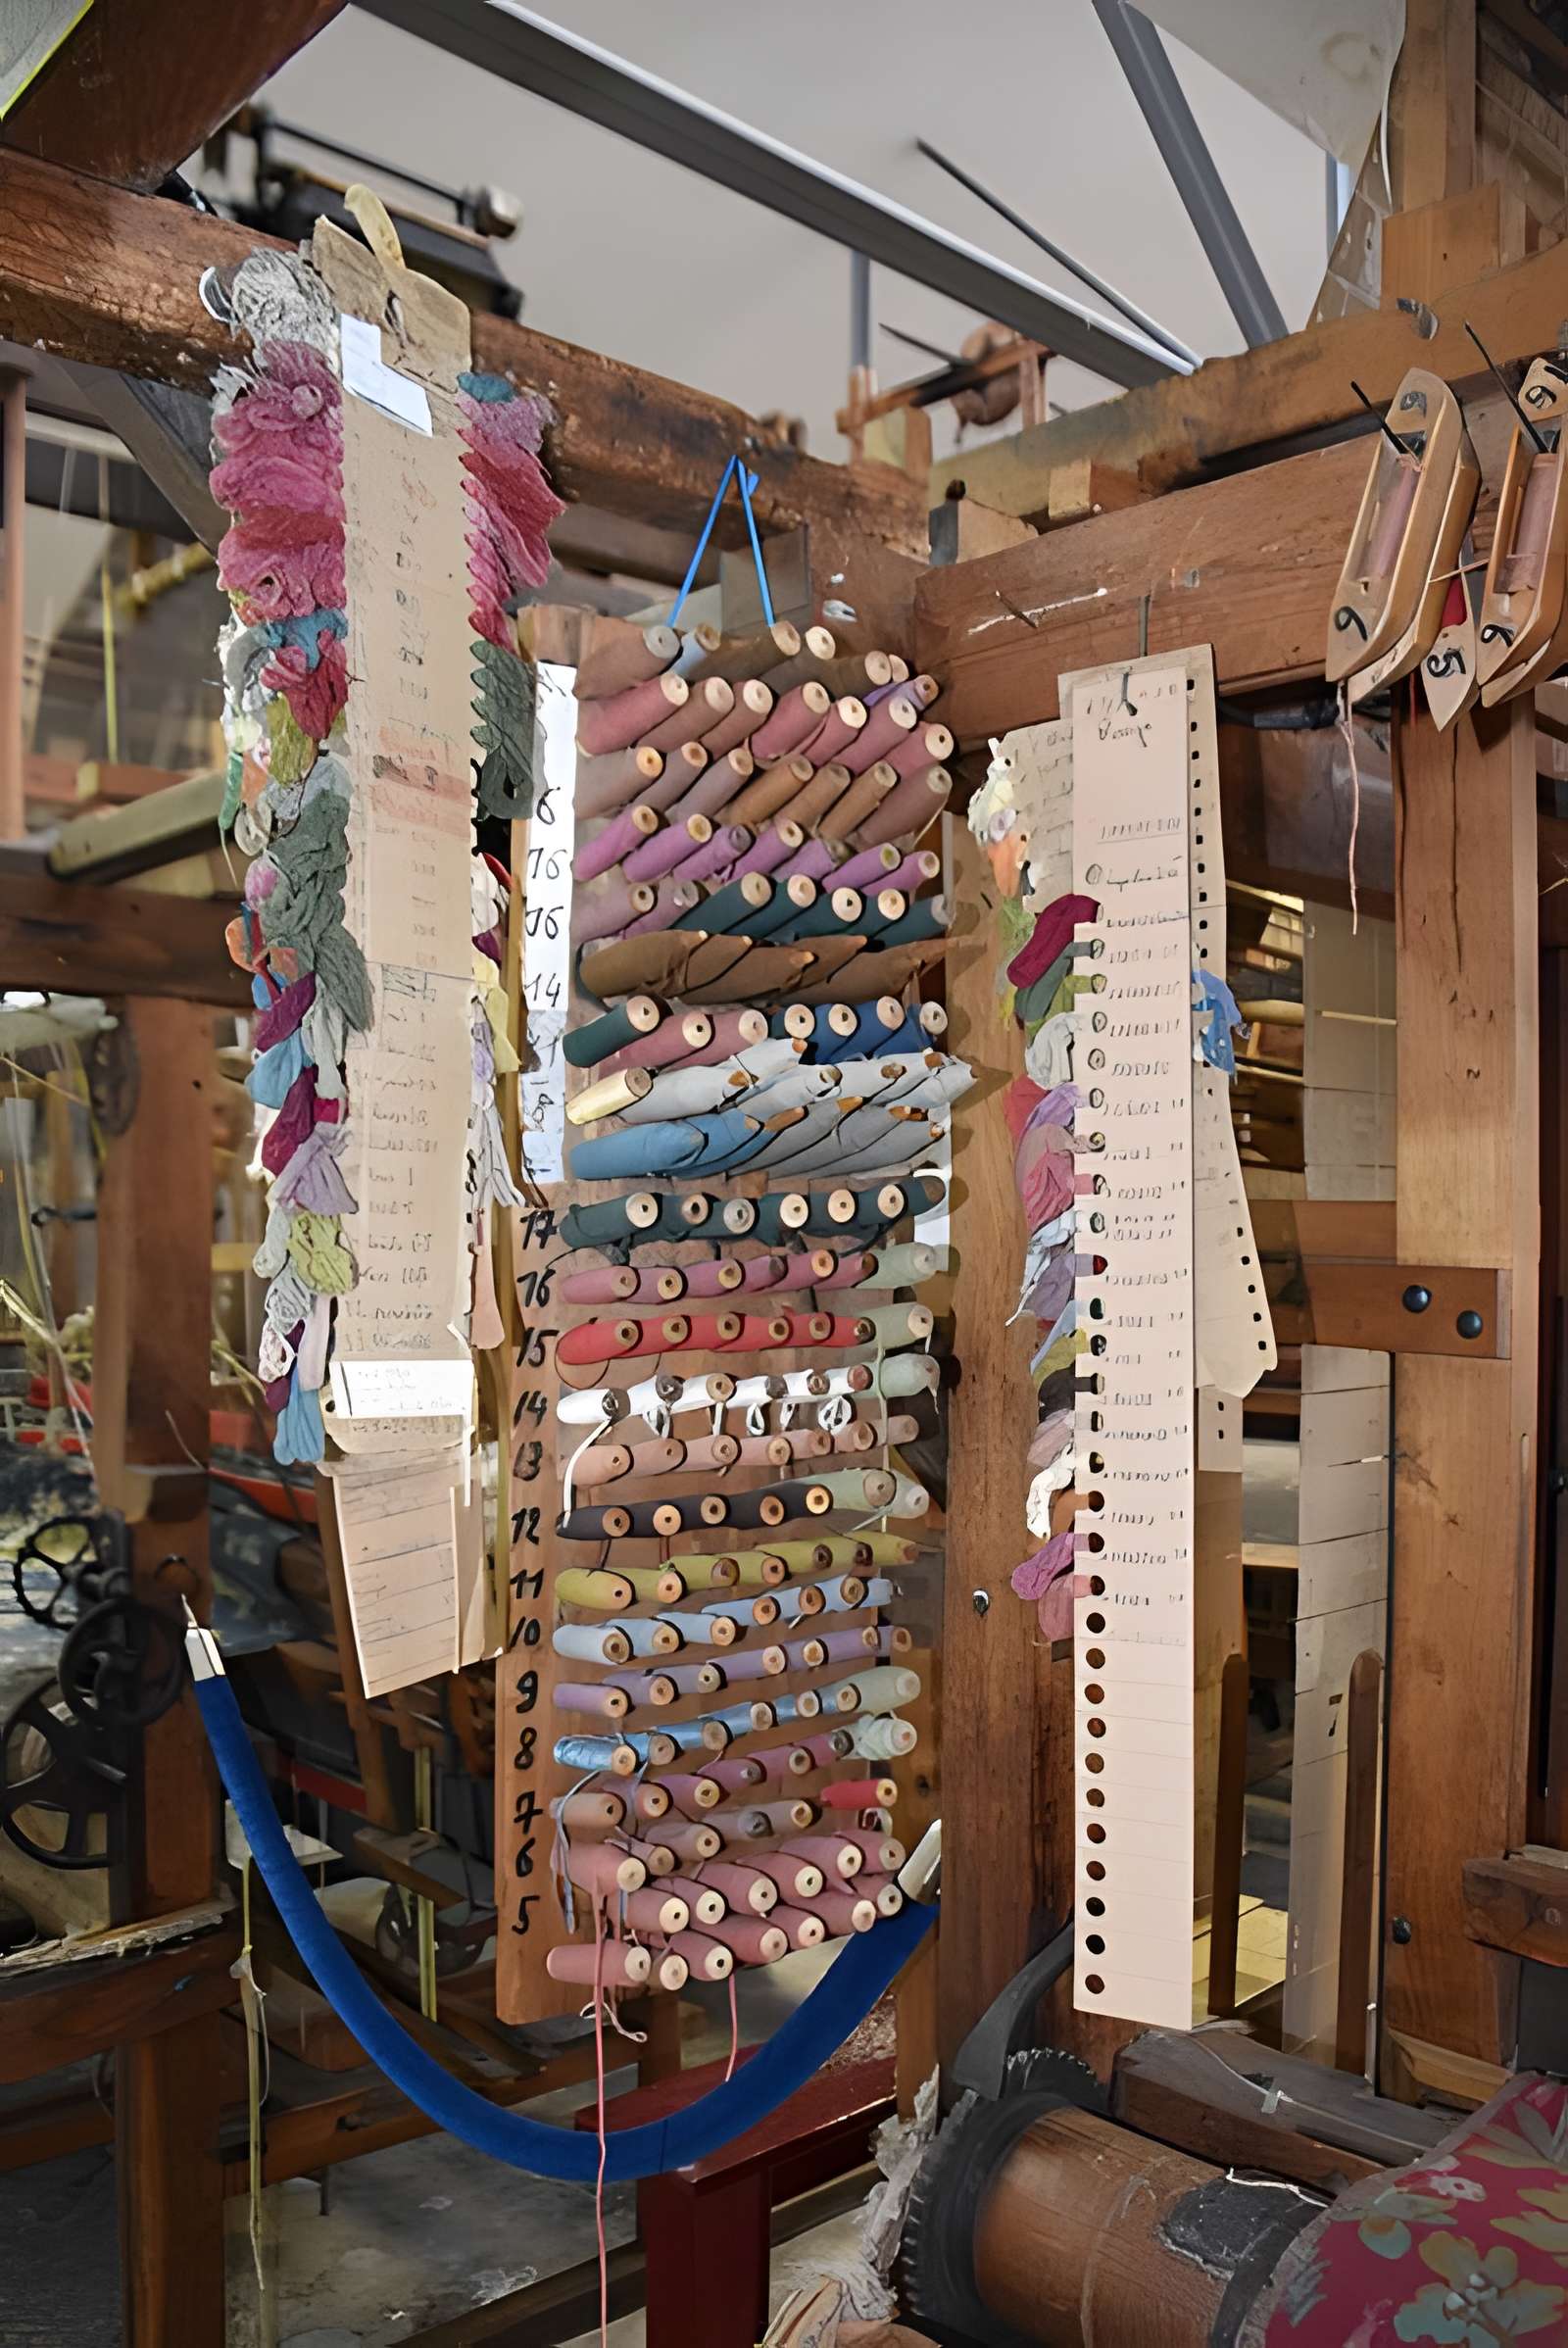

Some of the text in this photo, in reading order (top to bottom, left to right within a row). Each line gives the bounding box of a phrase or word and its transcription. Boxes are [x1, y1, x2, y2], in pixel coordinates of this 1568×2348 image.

[511, 1507, 540, 1544] 12
[509, 1569, 544, 1599] 11
[510, 1616, 540, 1647] 10
[515, 1670, 538, 1713] 9
[514, 1728, 537, 1769] 8
[514, 1791, 543, 1834] 7
[515, 1837, 535, 1878] 6
[512, 1895, 539, 1934] 5
